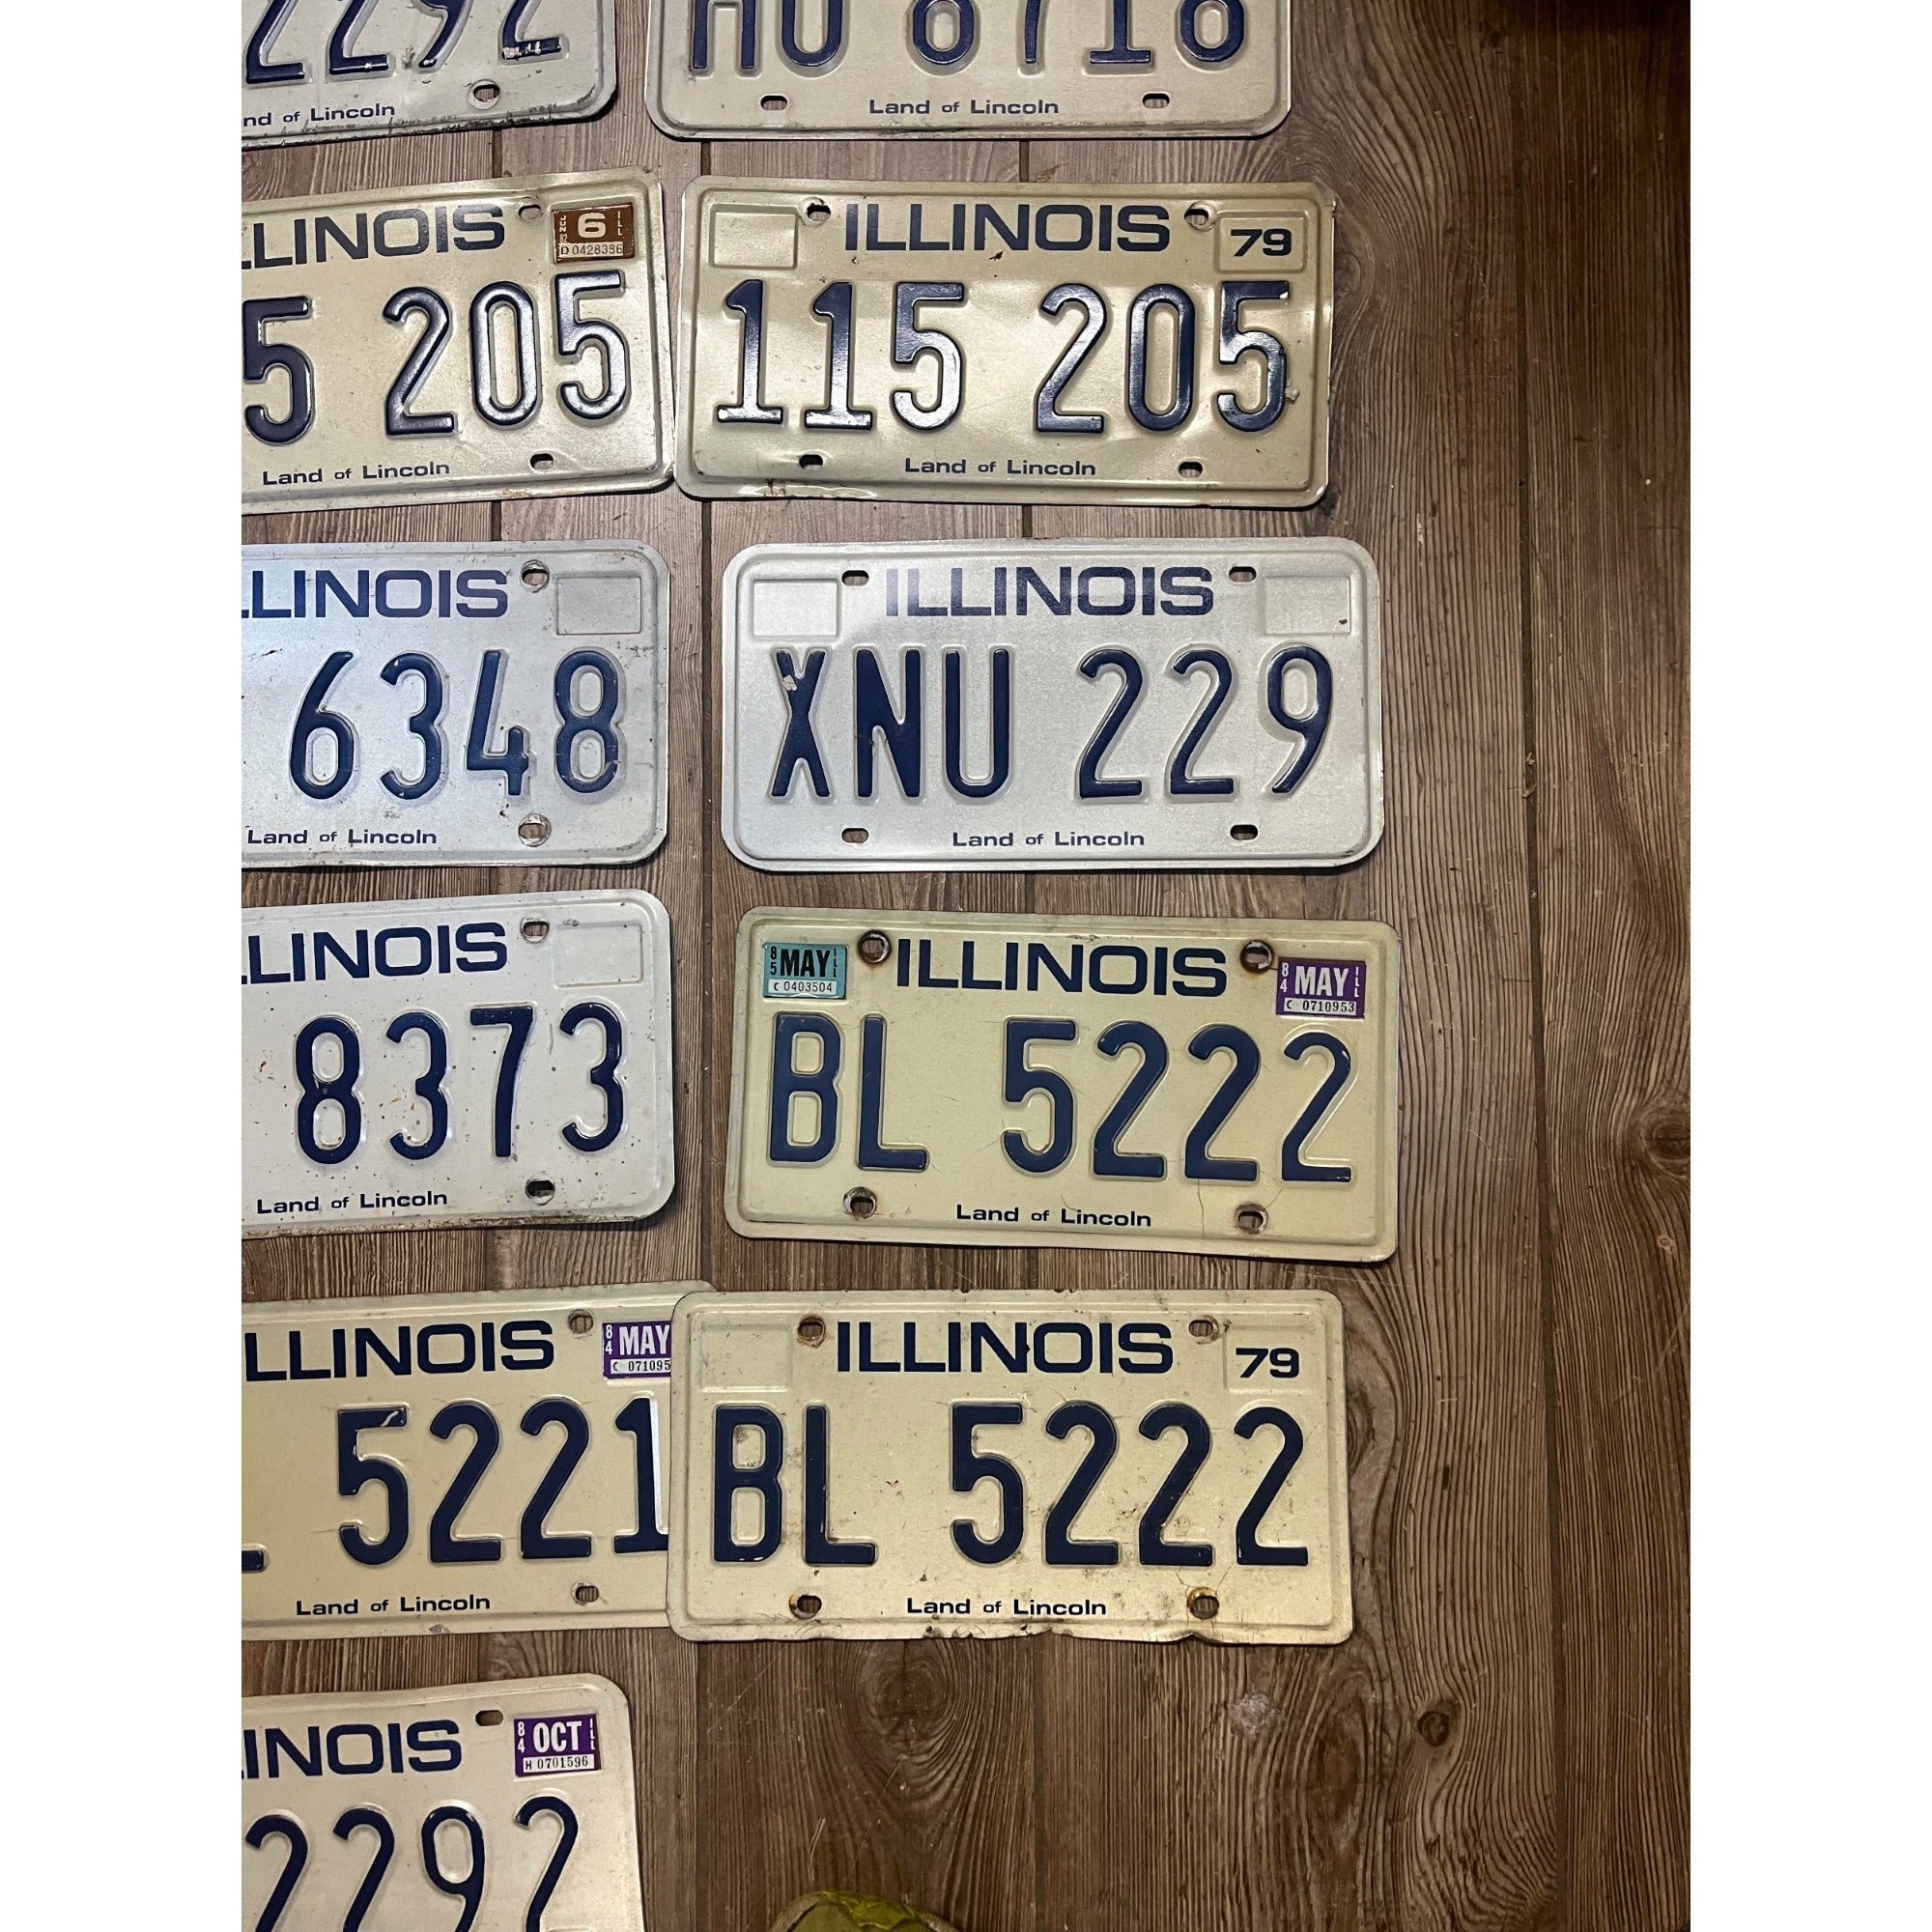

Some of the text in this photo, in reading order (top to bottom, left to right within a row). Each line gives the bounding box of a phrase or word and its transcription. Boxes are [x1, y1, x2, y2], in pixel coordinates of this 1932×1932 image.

[242, 103, 395, 128] nd of Lincoln
[870, 99, 1058, 114] Land of Lincoln
[242, 204, 505, 269] LINOIS
[578, 213, 607, 238] 6
[845, 204, 1170, 251] ILLINOIS
[560, 245, 569, 254] D
[1231, 229, 1292, 256] 79
[383, 270, 627, 436] 205
[717, 278, 1288, 432] 115 205
[264, 462, 449, 485] Land of Lincoln
[905, 458, 1095, 475] Land of Lincoln
[242, 570, 507, 618] LINOIS
[886, 566, 1214, 616] ILLINOIS
[290, 650, 618, 800] 6348
[771, 646, 1332, 799] XNU 229
[248, 829, 437, 844] Land of Lincoln
[953, 832, 1144, 846] Land of Lincoln
[242, 923, 507, 983] LINOIS
[770, 946, 777, 976] 85
[780, 949, 831, 978] MAY
[897, 939, 1227, 997] ILLINOIS
[774, 980, 832, 993] C 0403504
[1280, 962, 1289, 993] 84
[1294, 966, 1349, 997] MAY
[1302, 1000, 1354, 1012] 0710953
[296, 1003, 623, 1164] 8373
[770, 1011, 1352, 1182] BL 5222
[258, 1191, 447, 1213] Land of Lincoln
[957, 1205, 1151, 1227] Land of Lincoln
[605, 1324, 612, 1355] 84
[619, 1325, 670, 1355] MAY
[838, 1321, 1173, 1374] ILLINOIS
[1236, 1348, 1299, 1378] 79
[337, 1397, 669, 1565] 5221
[714, 1404, 1308, 1567] BL 5222
[297, 1595, 490, 1615] Land of Lincoln
[908, 1598, 1105, 1615] Land of Lincoln
[242, 1719, 462, 1778] INOIS
[518, 1721, 526, 1753] 84
[533, 1720, 582, 1753] OCT
[526, 1755, 588, 1771] H 0701596
[245, 1797, 578, 1932] 2292
